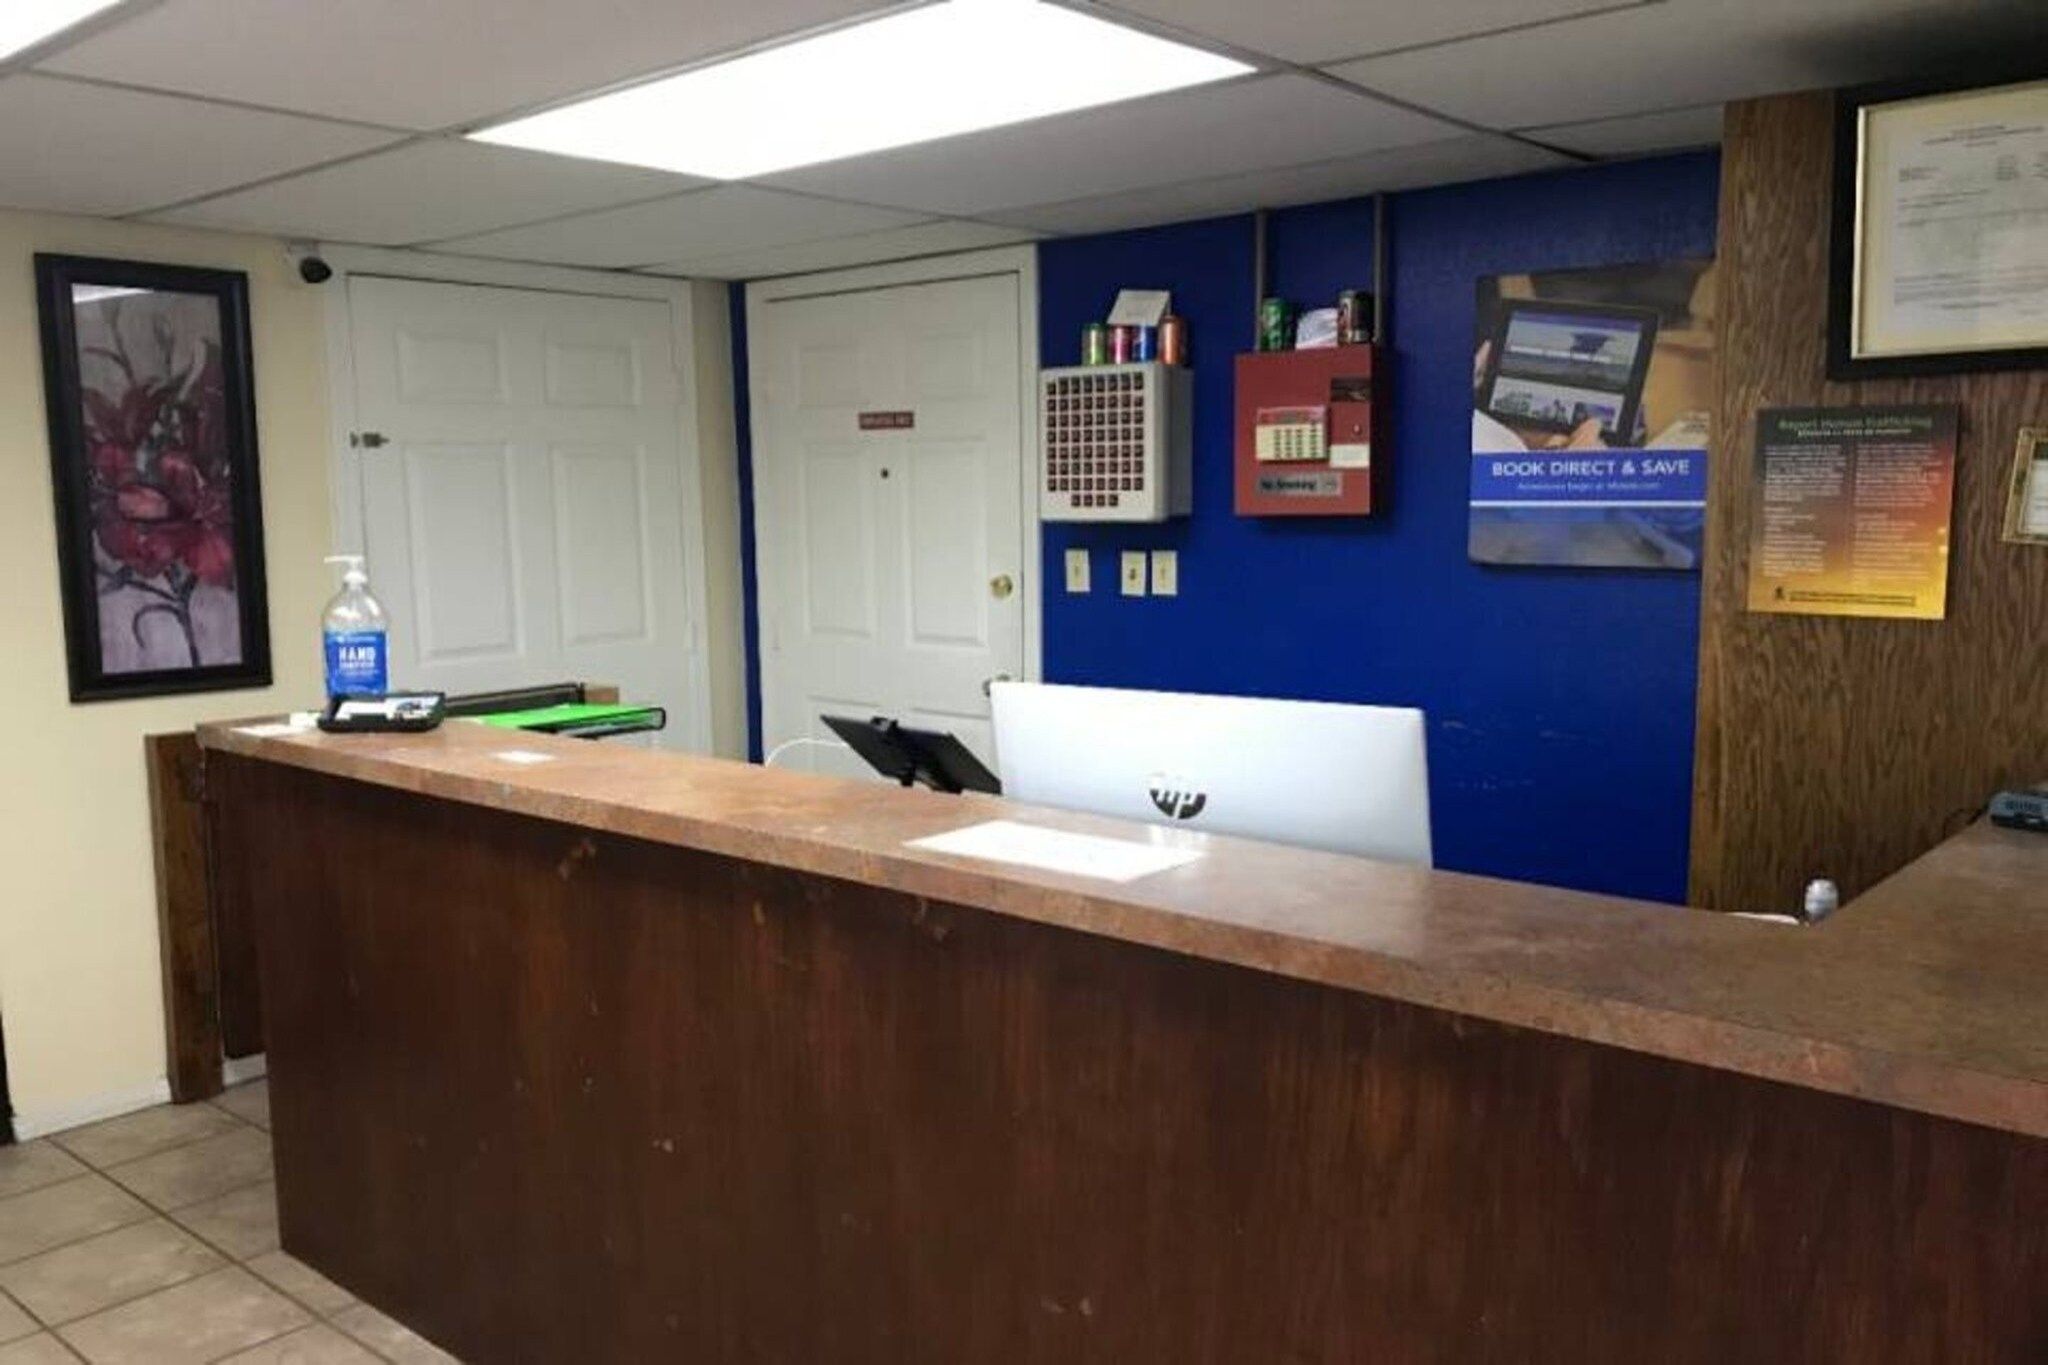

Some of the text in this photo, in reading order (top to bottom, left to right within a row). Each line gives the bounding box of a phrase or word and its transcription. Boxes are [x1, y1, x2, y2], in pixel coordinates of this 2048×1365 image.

[1491, 458, 1691, 477] BOOK DIRECT & SAVE
[338, 646, 376, 661] HAND
